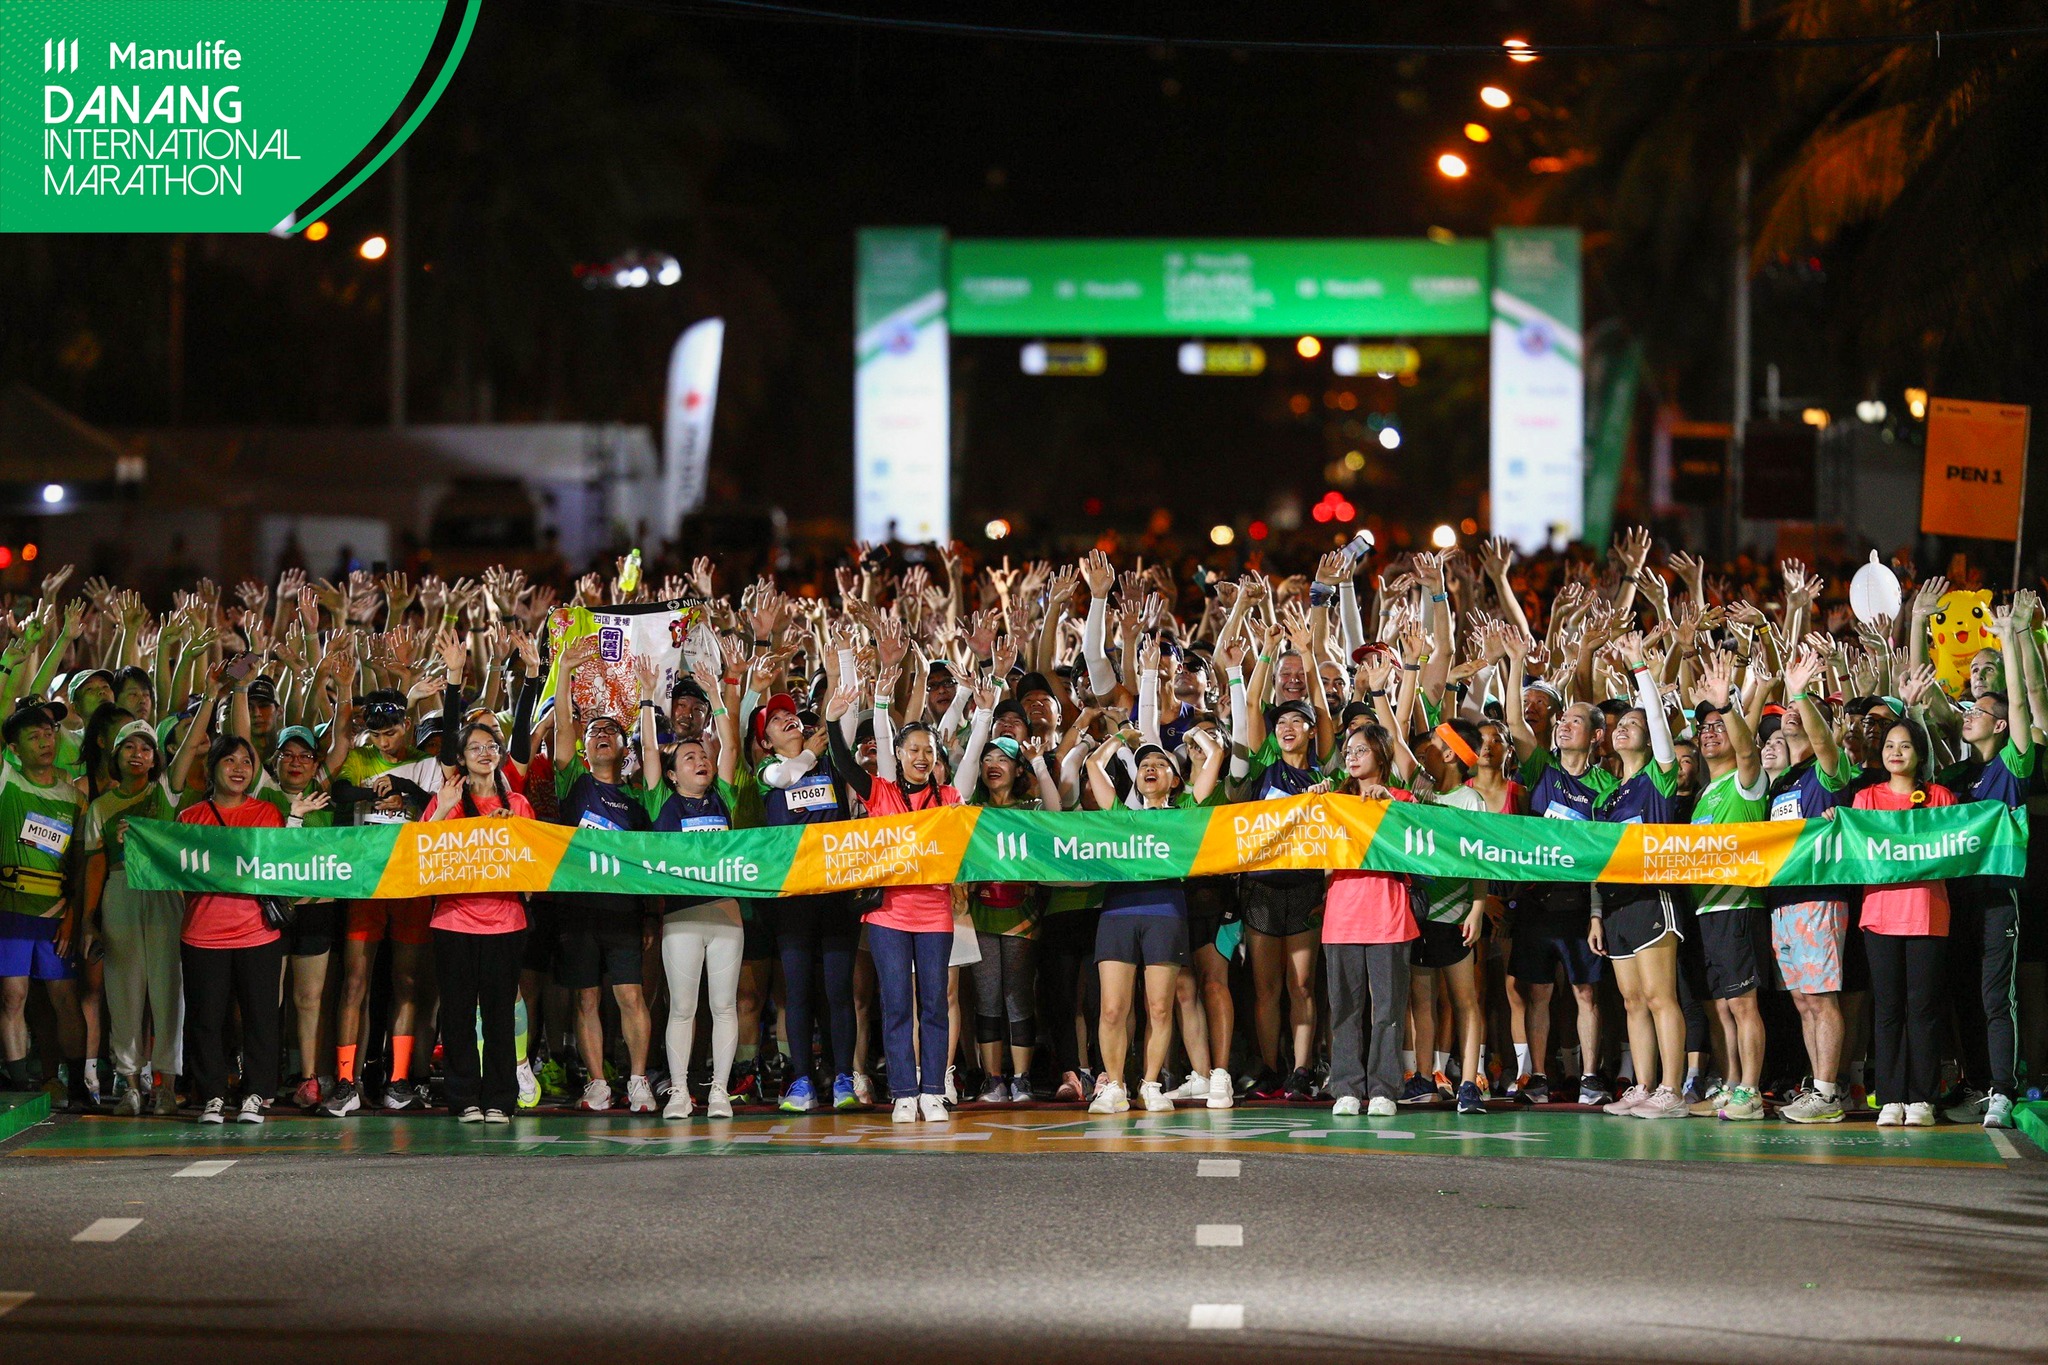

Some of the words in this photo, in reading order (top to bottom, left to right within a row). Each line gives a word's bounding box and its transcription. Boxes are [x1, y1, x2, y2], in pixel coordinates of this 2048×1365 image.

[1946, 465, 1988, 482] PEN
[1992, 470, 2003, 483] 1
[791, 787, 826, 801] F10687
[1233, 804, 1326, 834] DANANG
[28, 824, 61, 844] M10181
[417, 827, 509, 853] DANANG
[822, 824, 917, 853] DANANG
[1053, 834, 1170, 860] Manulife
[1236, 824, 1352, 850] INTERNATIONAL
[1643, 834, 1738, 854] DANANG
[1867, 829, 1981, 862] Manulife
[419, 847, 537, 869] INTERNATIONAL
[825, 840, 944, 869] INTERNATIONAL
[1238, 841, 1327, 865] MARATHON
[1459, 836, 1575, 868] Manulife
[1643, 850, 1765, 868] INTERNATIONAL
[236, 854, 353, 881] Manulife
[419, 864, 510, 885] MARATHON
[642, 856, 759, 883] Manulife
[826, 860, 919, 886] MARATHON
[1643, 867, 1738, 882] MARATHON
